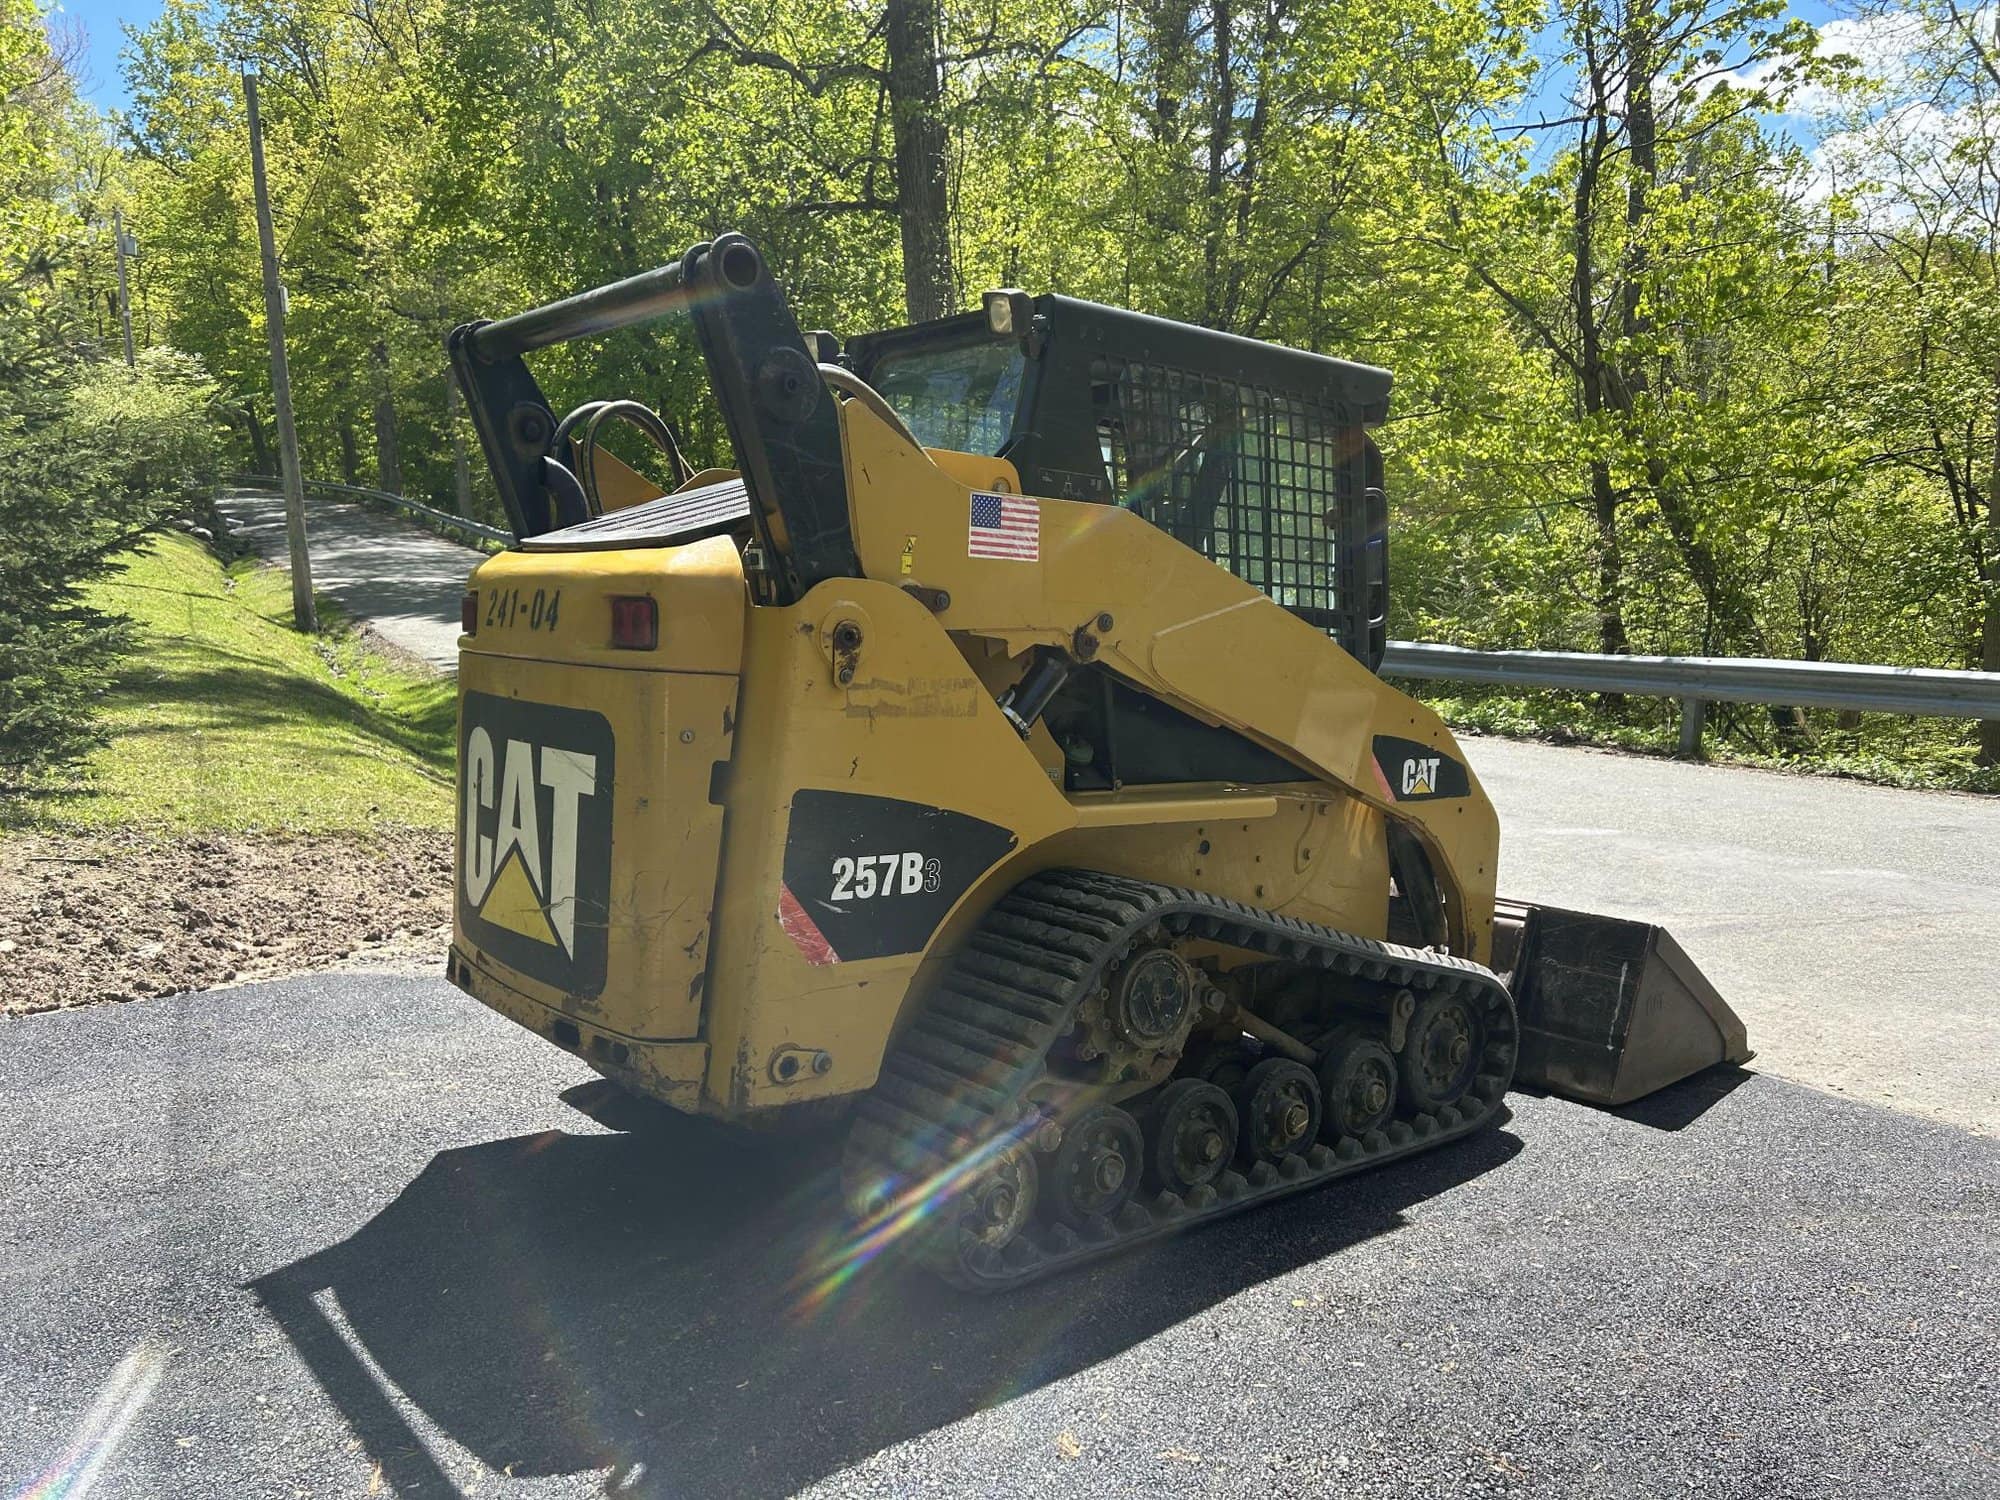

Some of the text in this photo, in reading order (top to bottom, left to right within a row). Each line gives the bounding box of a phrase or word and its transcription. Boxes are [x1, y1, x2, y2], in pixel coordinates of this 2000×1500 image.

[486, 588, 561, 632] 241-04
[1402, 758, 1440, 795] CAT
[466, 726, 597, 961] CAT
